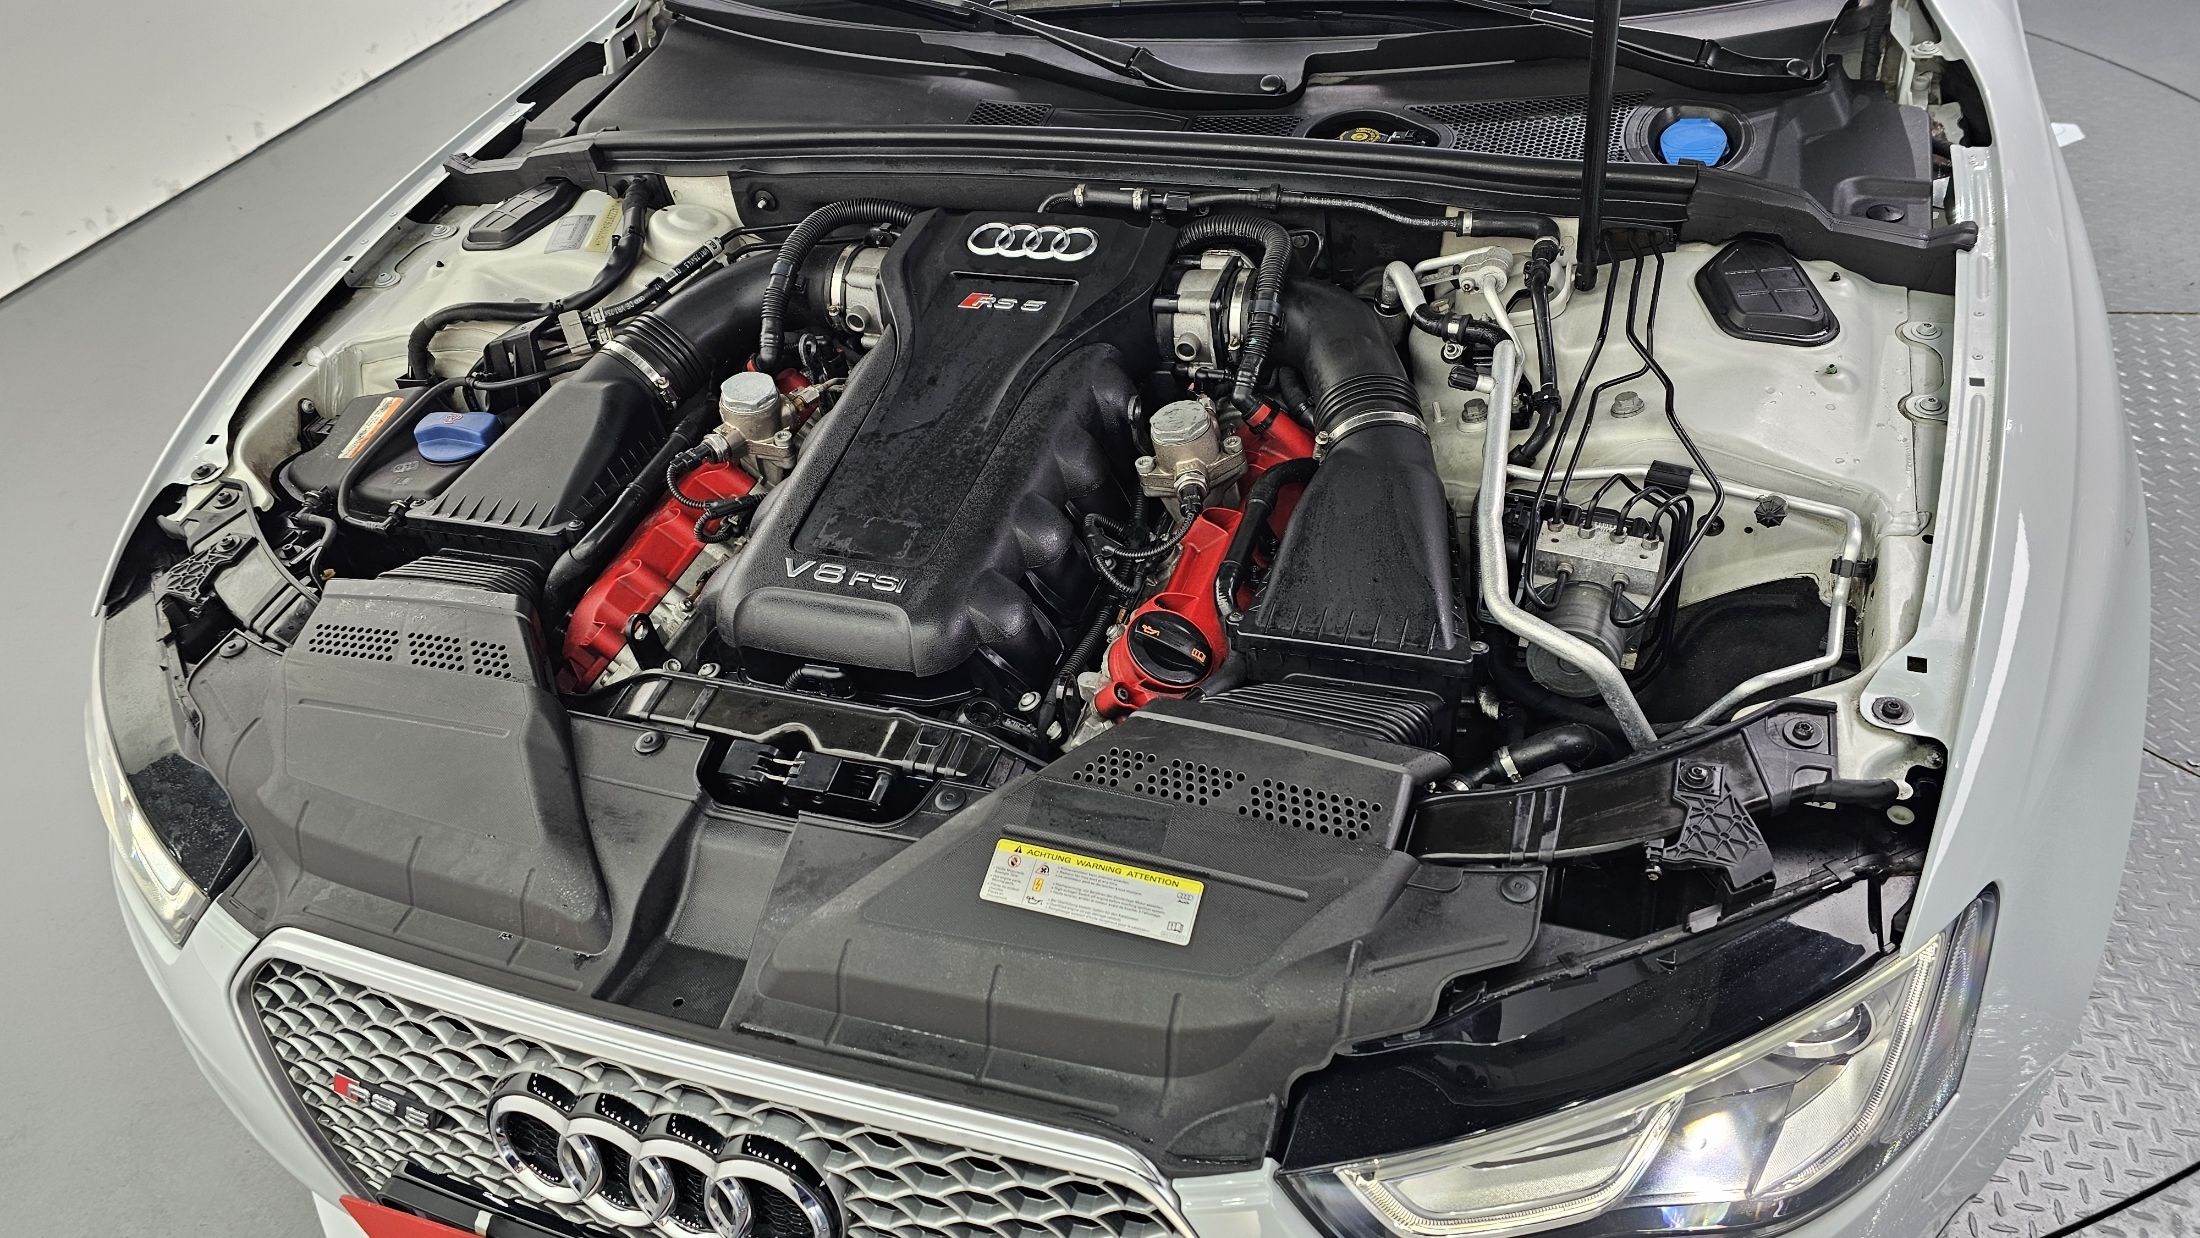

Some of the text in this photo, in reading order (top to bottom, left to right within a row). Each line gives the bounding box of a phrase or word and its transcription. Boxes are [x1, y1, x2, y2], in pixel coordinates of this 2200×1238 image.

[960, 293, 1047, 311] RS 5
[785, 557, 907, 593] V8 FSI
[1026, 849, 1071, 864] ACHTUNG
[1076, 859, 1122, 875] WARNING
[1126, 870, 1180, 888] ATTENTION
